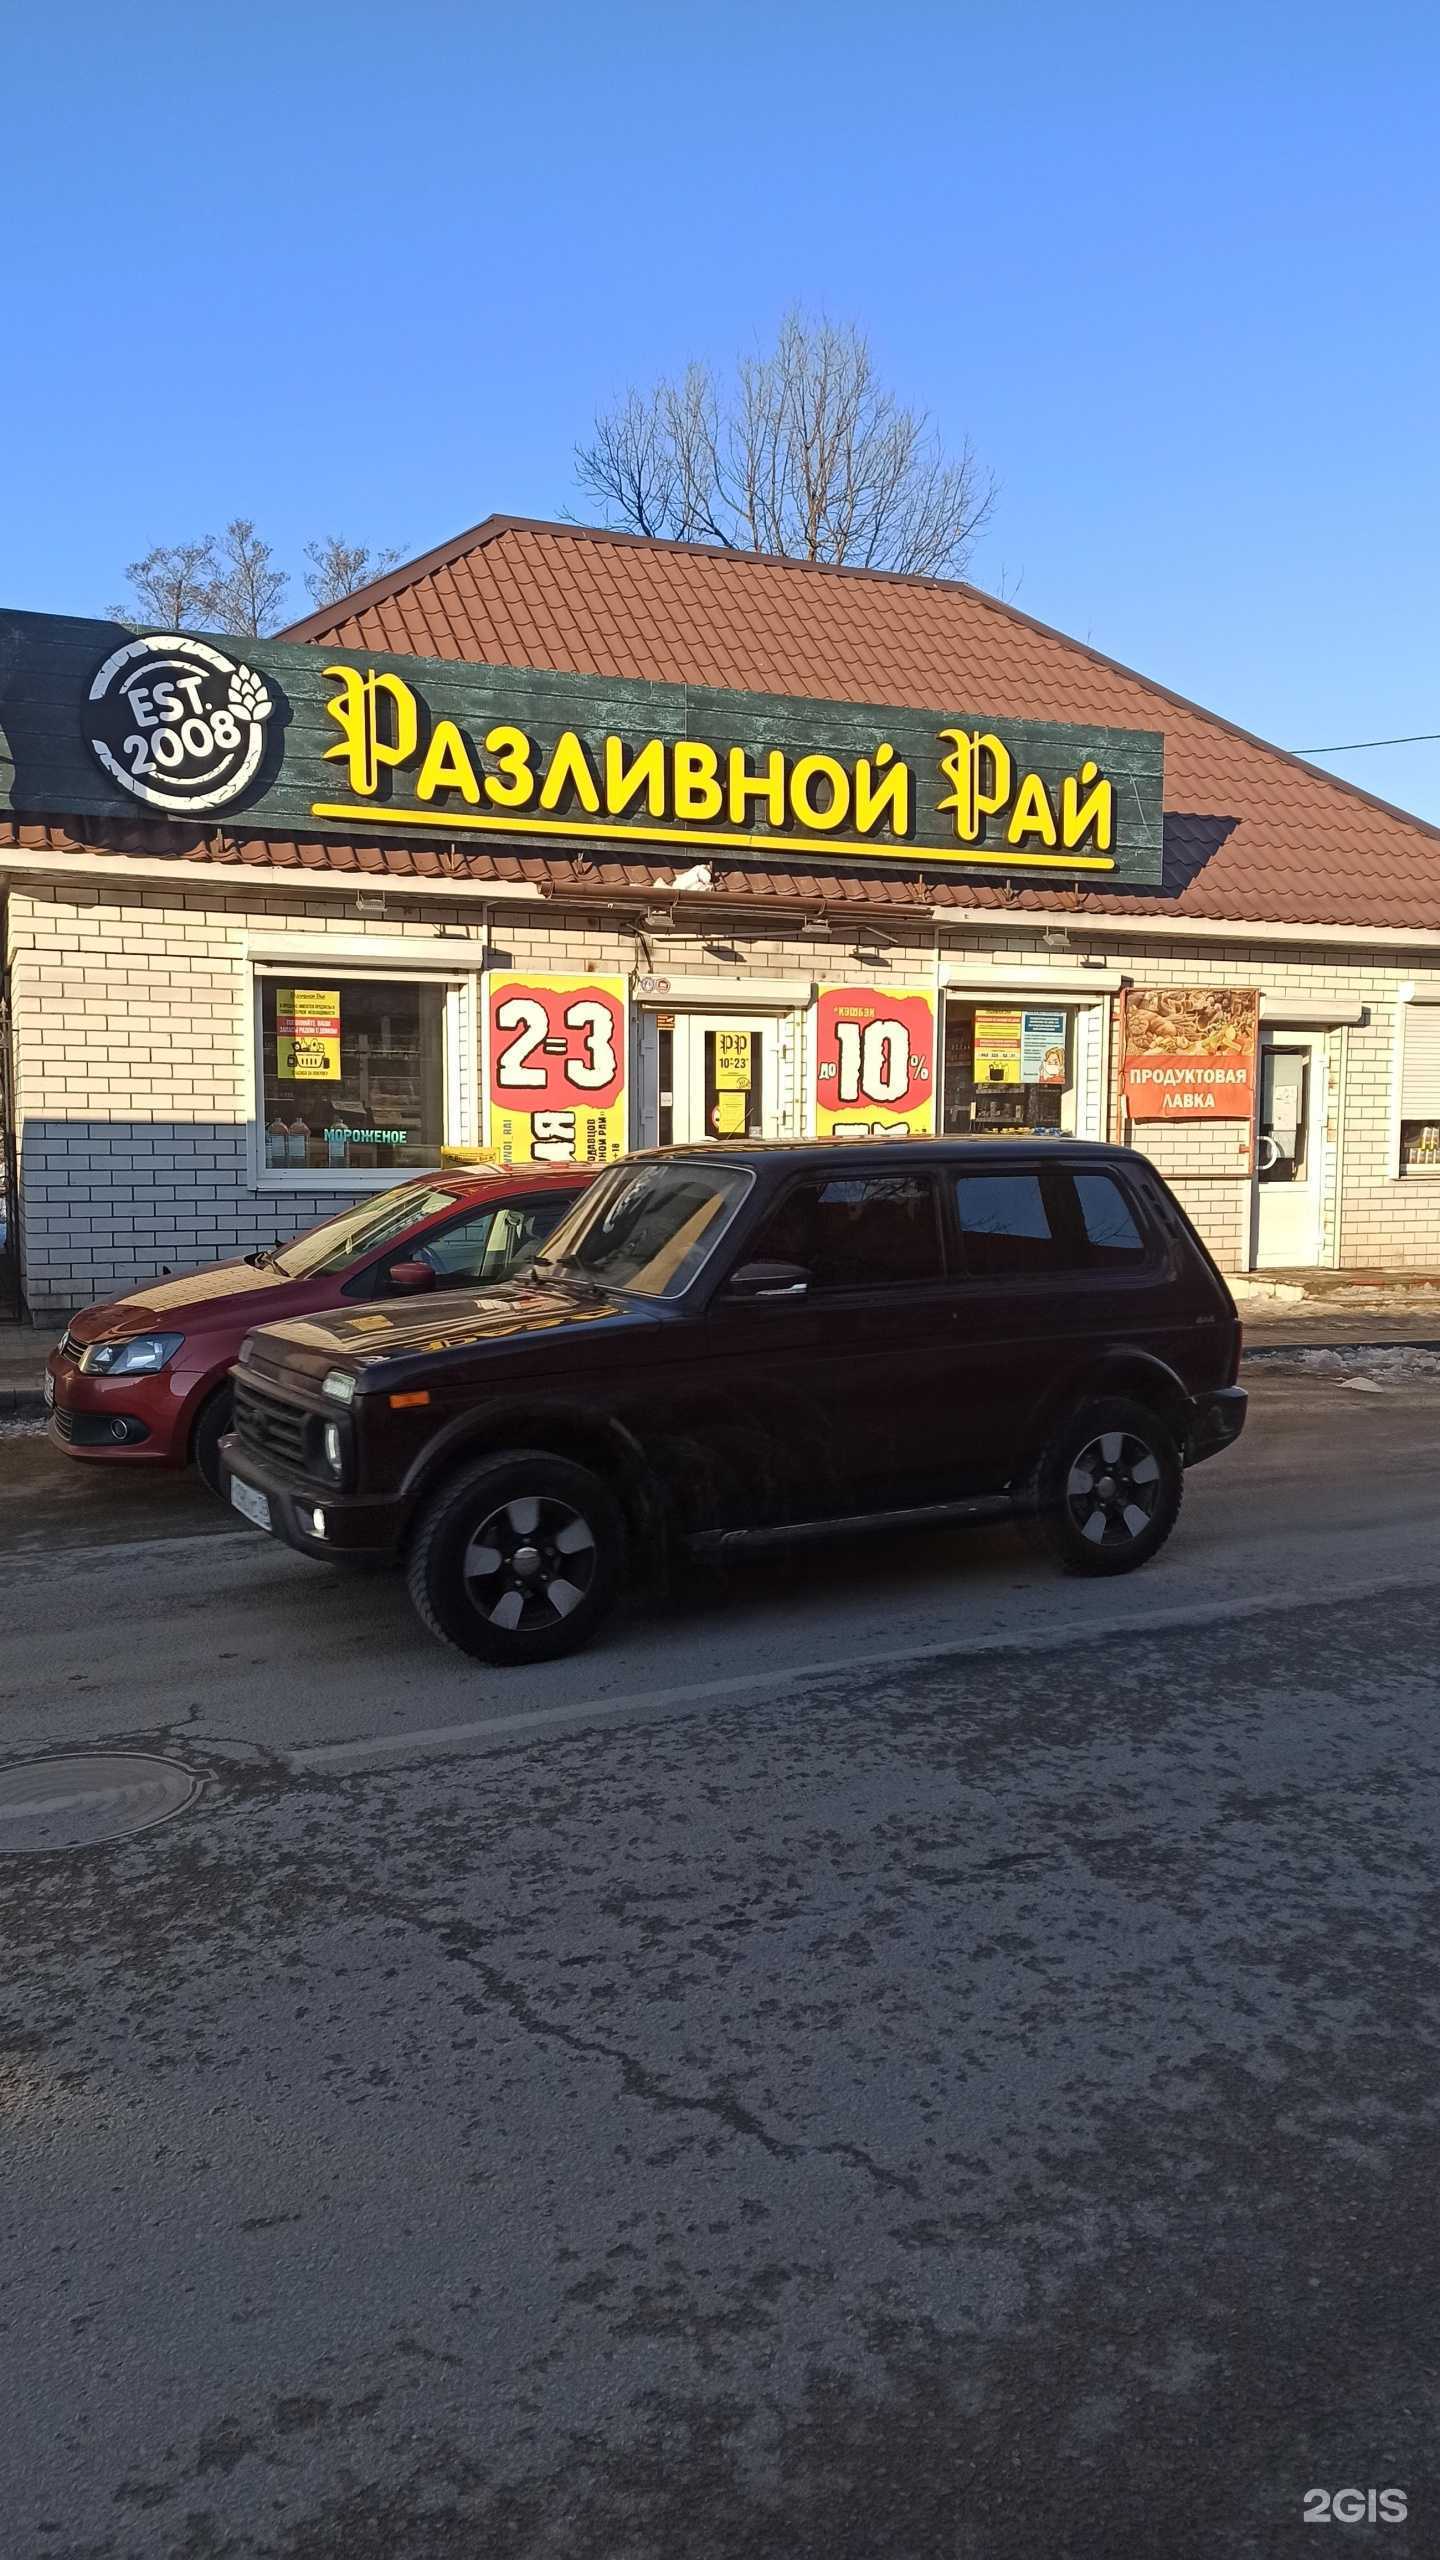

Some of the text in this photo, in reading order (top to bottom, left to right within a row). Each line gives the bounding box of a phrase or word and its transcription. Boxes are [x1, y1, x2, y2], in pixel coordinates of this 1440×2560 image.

[127, 676, 212, 728] EST.
[123, 709, 241, 775] 2008
[322, 665, 1113, 851] РАЗЛИВНОЙ РАЙ
[1129, 1068, 1247, 1086] ПРОДУКТОВАЯ
[1162, 1093, 1216, 1109] ЛАВКА
[323, 1128, 407, 1144] МОРОЖЕНОЕ
